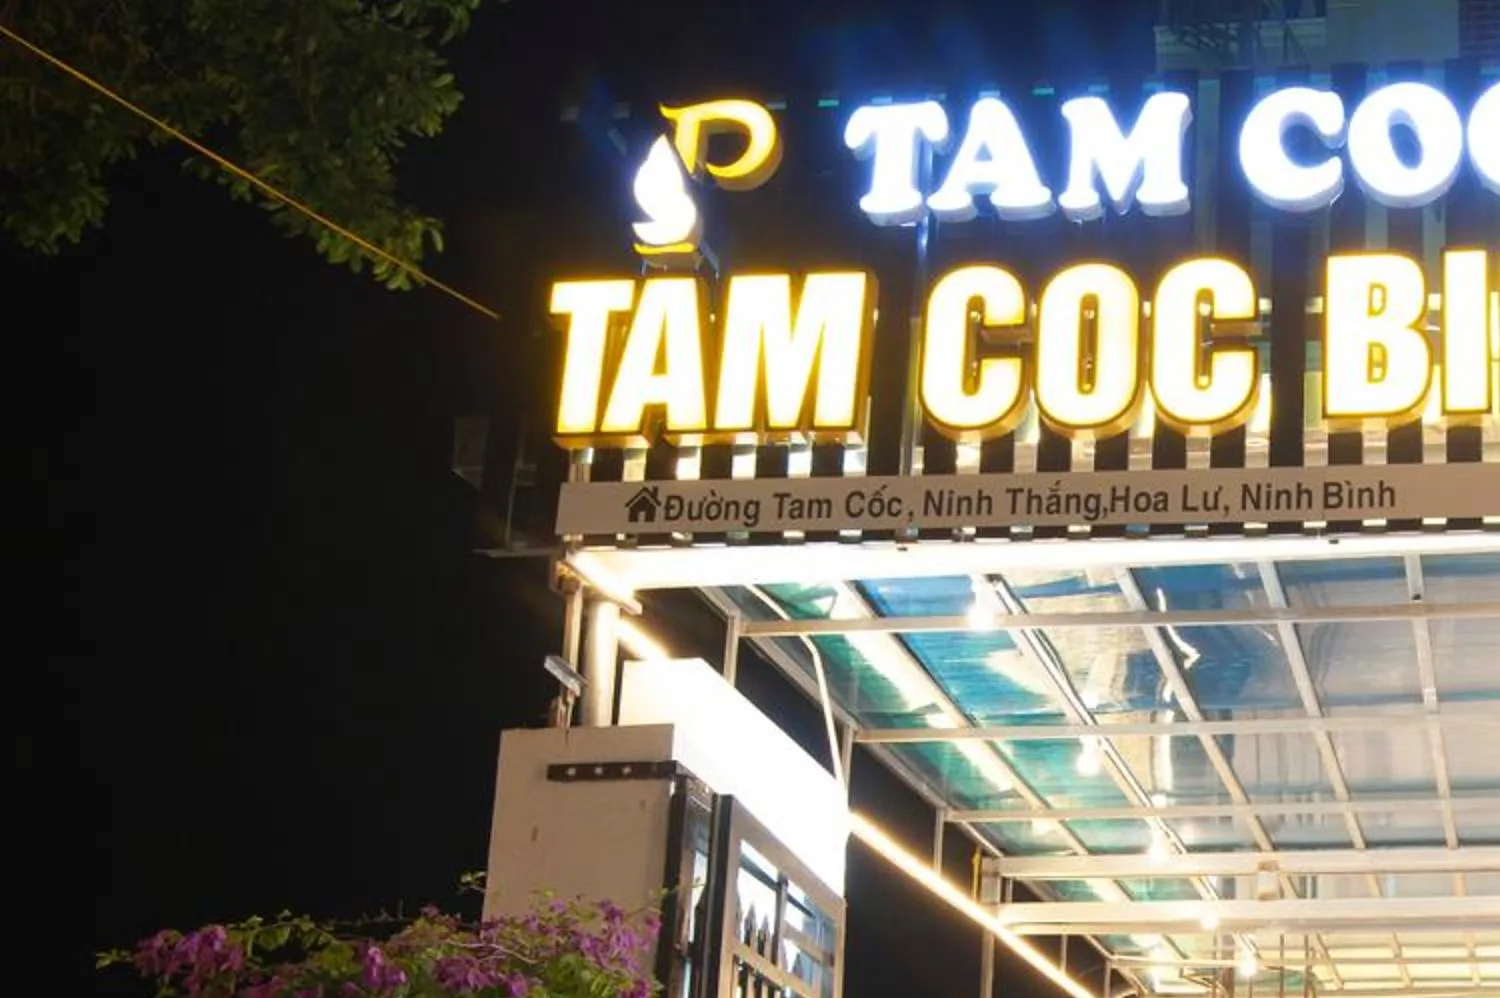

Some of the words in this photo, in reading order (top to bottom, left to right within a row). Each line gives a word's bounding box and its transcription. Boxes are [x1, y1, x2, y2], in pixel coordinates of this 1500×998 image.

[843, 92, 1192, 222] TAM
[549, 270, 878, 446] TAM
[919, 257, 1261, 440] COC
[663, 489, 761, 526] Đường
[772, 493, 833, 520] Tam
[923, 490, 993, 517] Ninh
[1181, 483, 1230, 517] Lư,
[1240, 483, 1312, 512] Ninh
[1323, 480, 1395, 510] Bình
